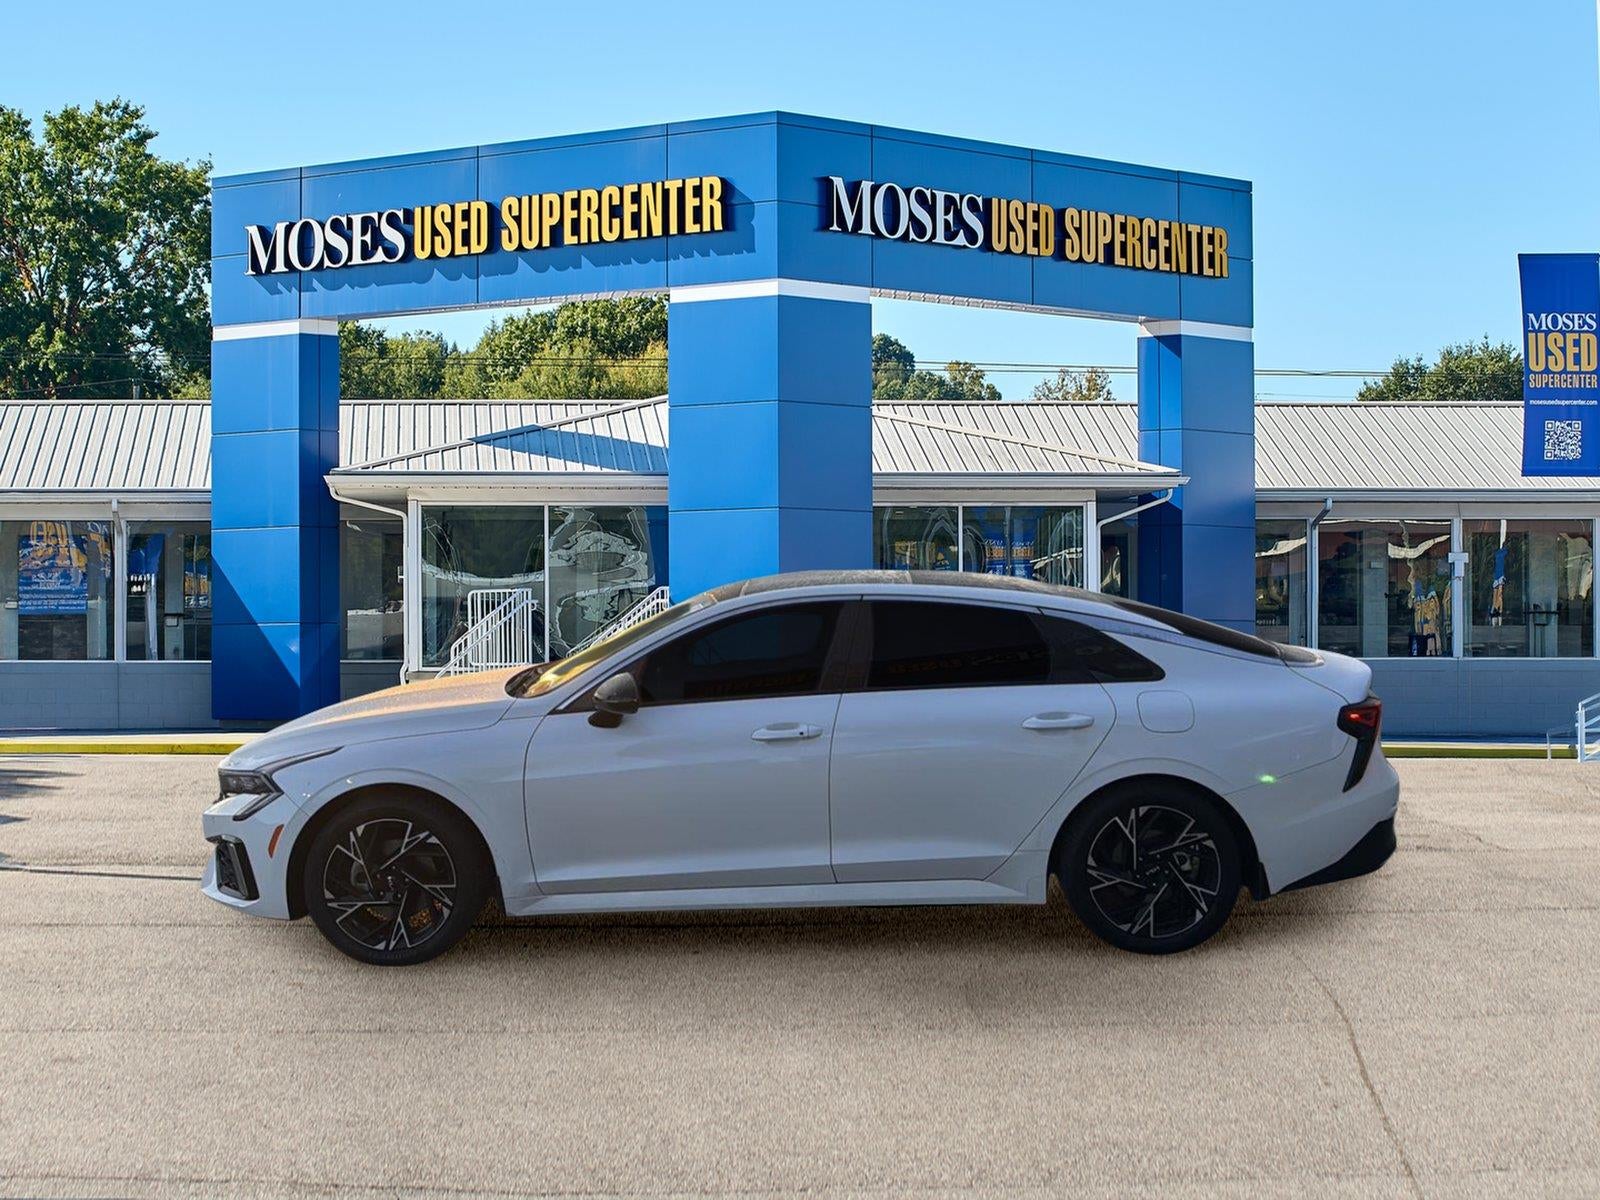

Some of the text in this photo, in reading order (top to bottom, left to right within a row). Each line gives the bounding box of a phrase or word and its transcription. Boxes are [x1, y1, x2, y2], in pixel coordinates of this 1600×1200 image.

[245, 175, 723, 276] MOSES USED SUPERCENTER
[829, 176, 1229, 278] MOSES USED SUPERCENTER
[1528, 313, 1597, 331] MOSES
[1528, 333, 1597, 372] USED
[1530, 374, 1597, 388] SUPERCENTER
